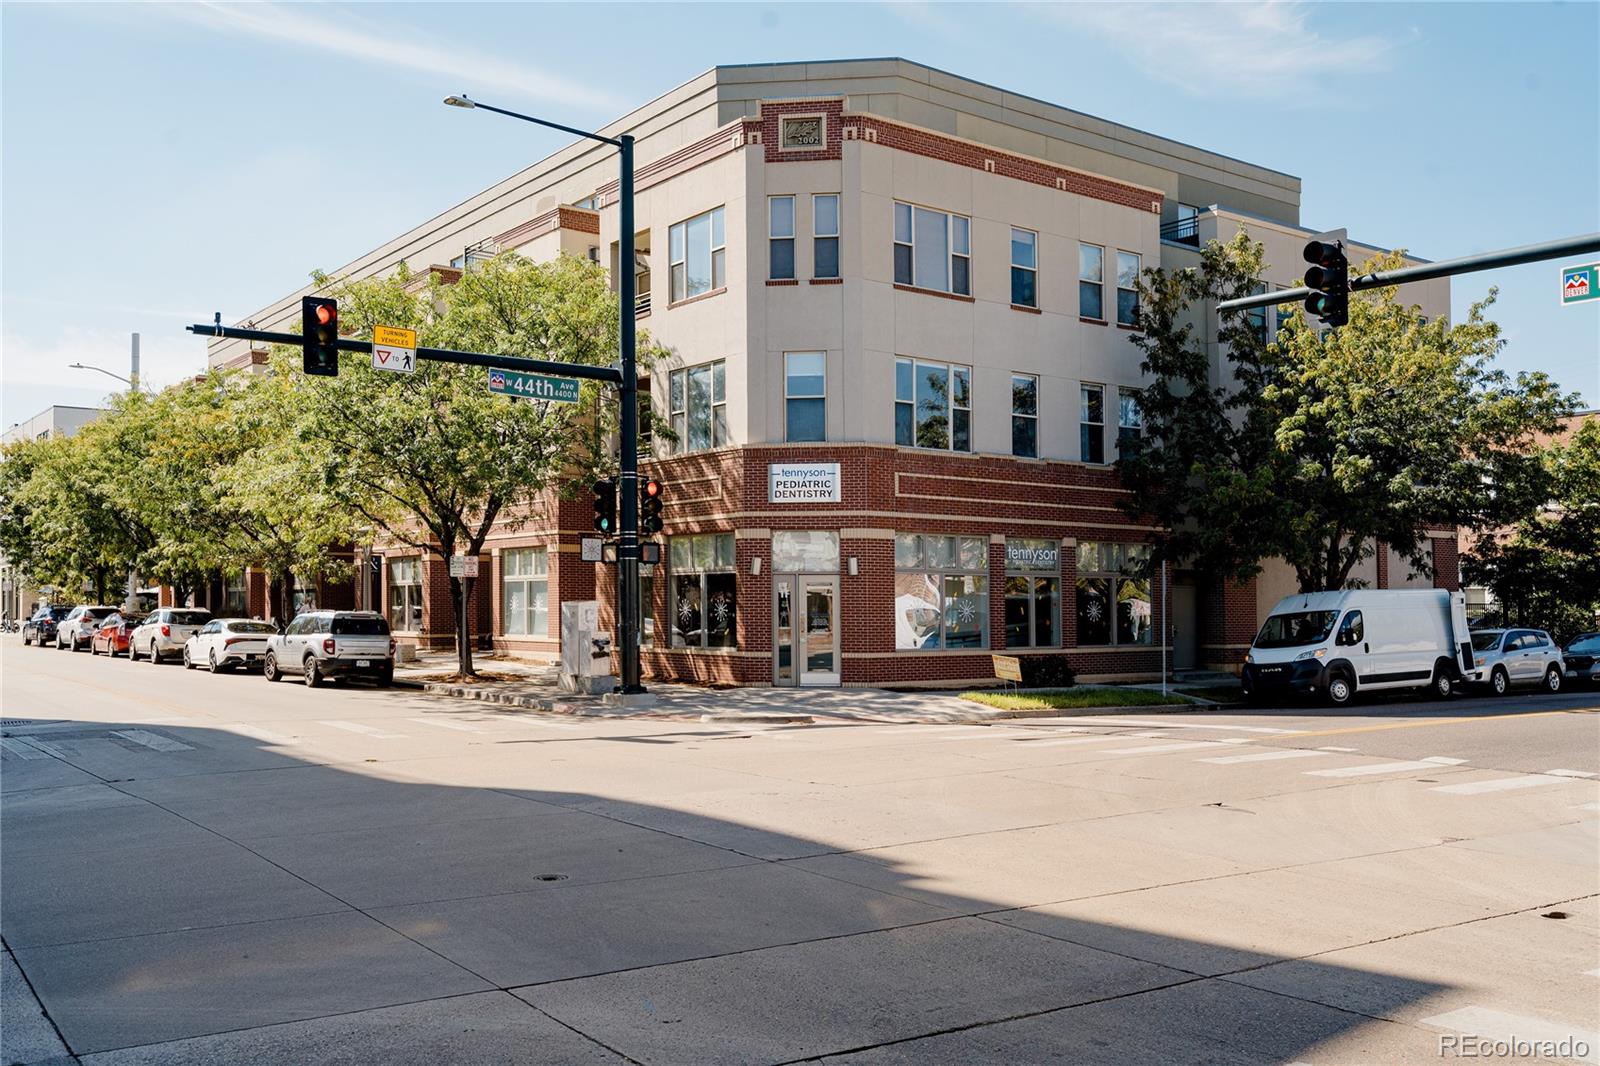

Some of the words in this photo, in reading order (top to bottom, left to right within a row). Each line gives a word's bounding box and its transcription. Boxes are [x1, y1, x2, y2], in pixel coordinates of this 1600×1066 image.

[381, 337, 408, 346] VEHICLES
[514, 377, 554, 397] 44th
[560, 382, 574, 391] Ave
[554, 389, 572, 398] 4400
[782, 468, 826, 479] tennyson
[776, 480, 831, 488] PEDIATRIC
[774, 490, 833, 498] DENTISTRY
[1008, 546, 1057, 564] tennyson
